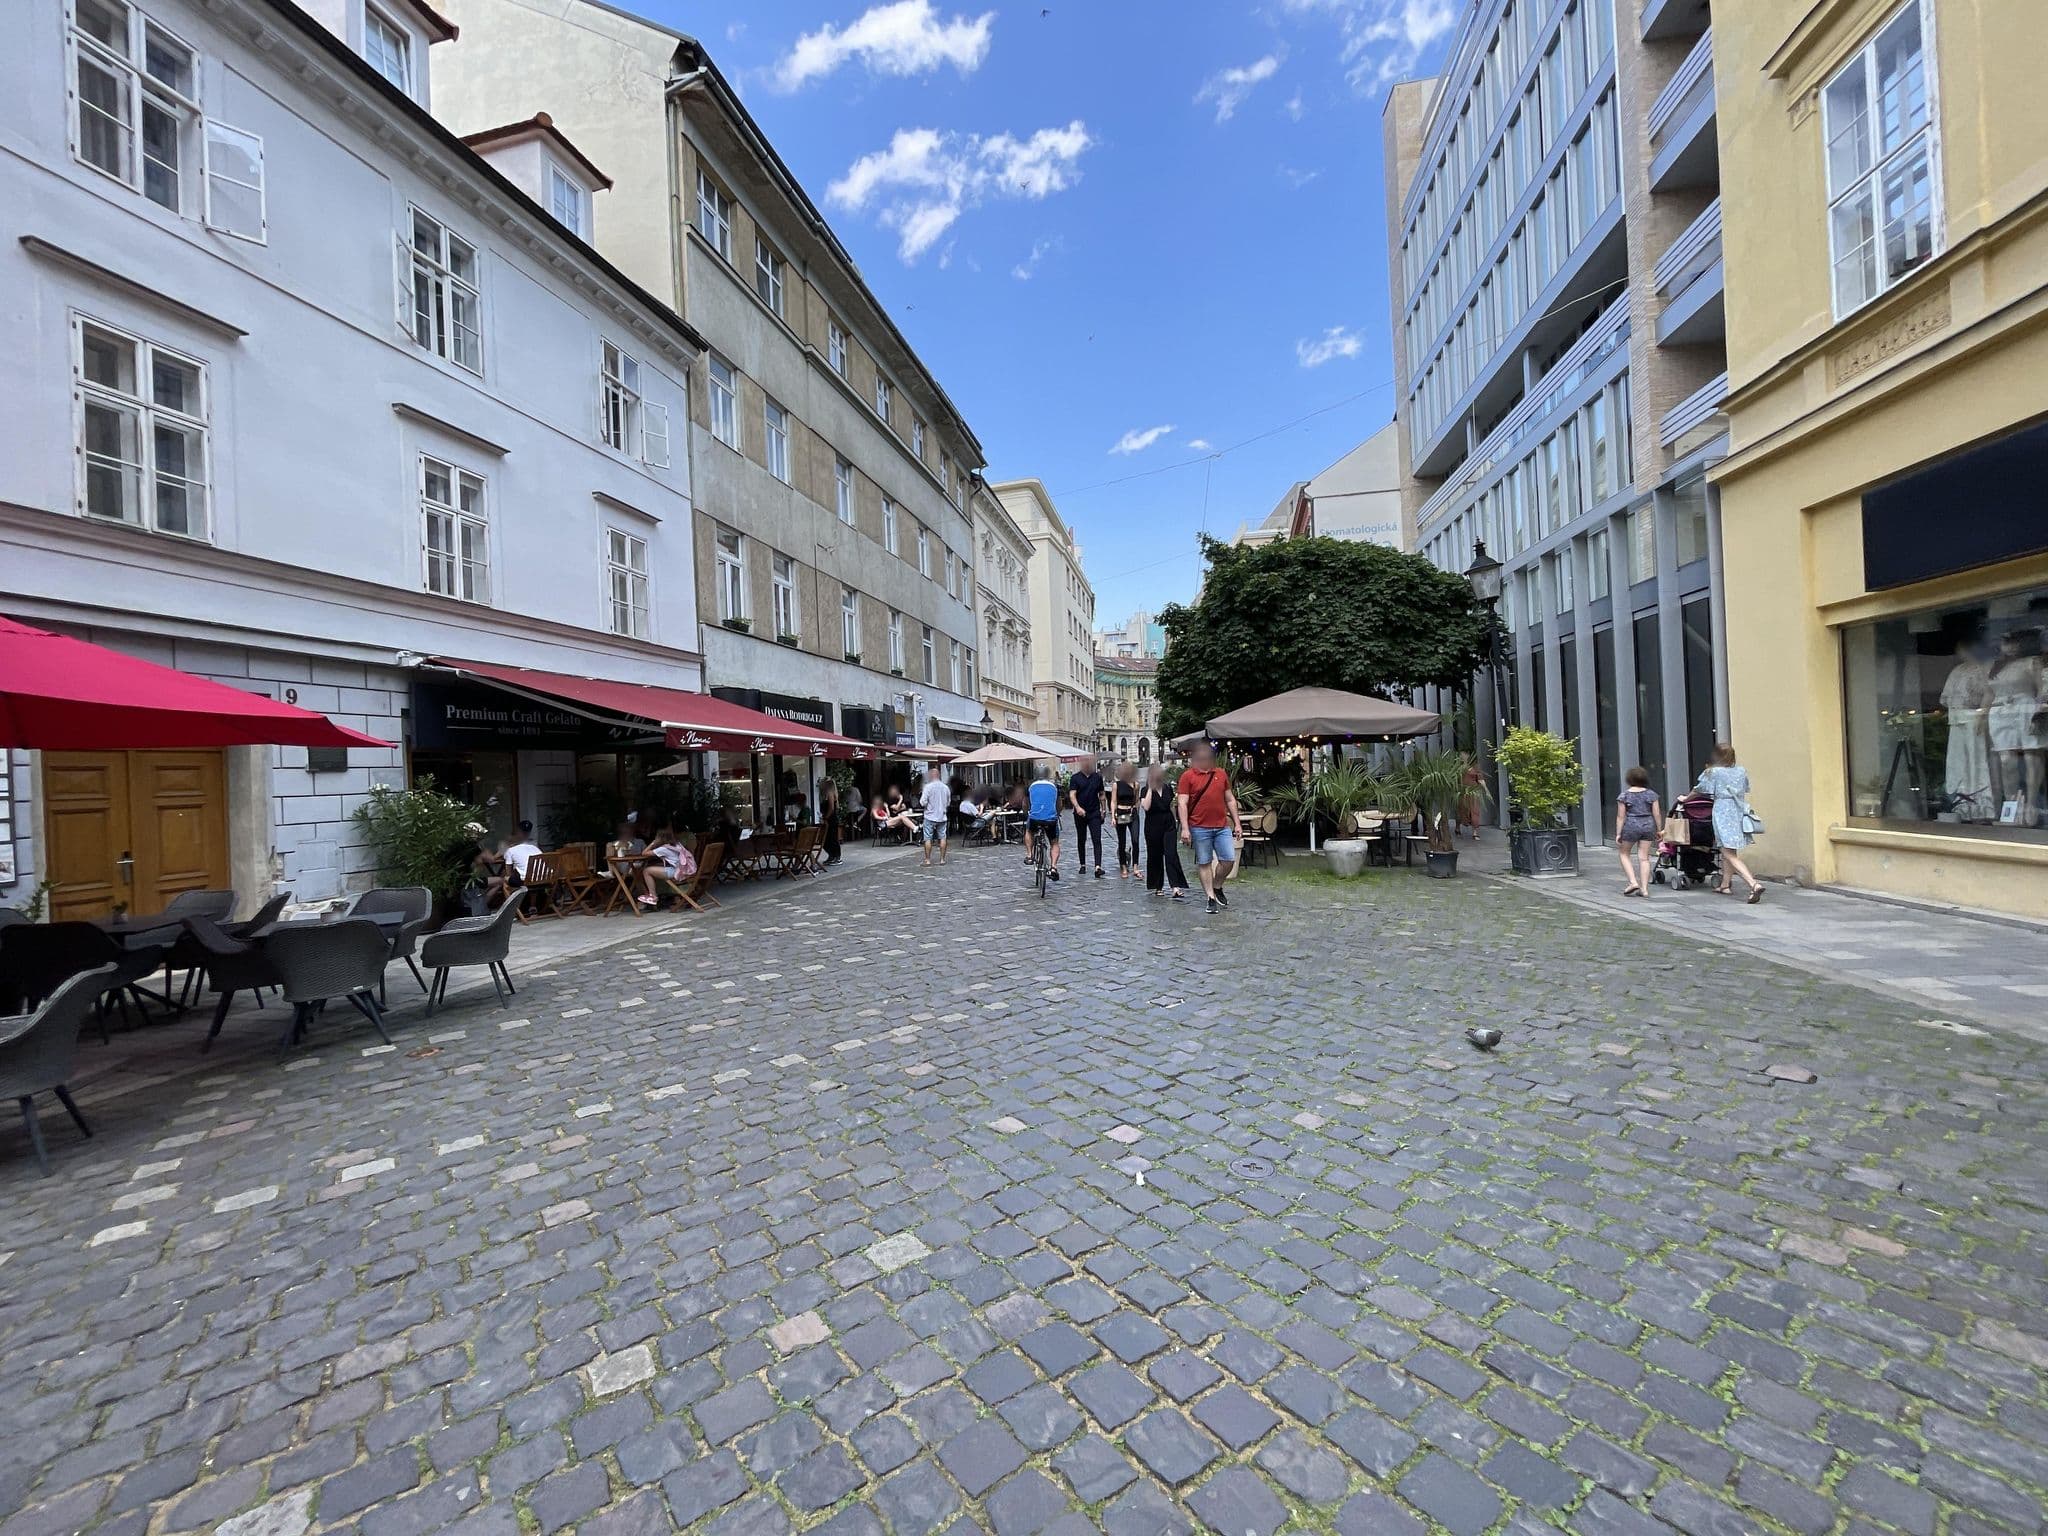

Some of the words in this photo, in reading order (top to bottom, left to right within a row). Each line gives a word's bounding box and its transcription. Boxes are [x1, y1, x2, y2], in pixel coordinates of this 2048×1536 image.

[286, 688, 298, 704] 9
[446, 704, 508, 721] Premium
[511, 709, 541, 723] Craft
[545, 712, 581, 726] Gelato
